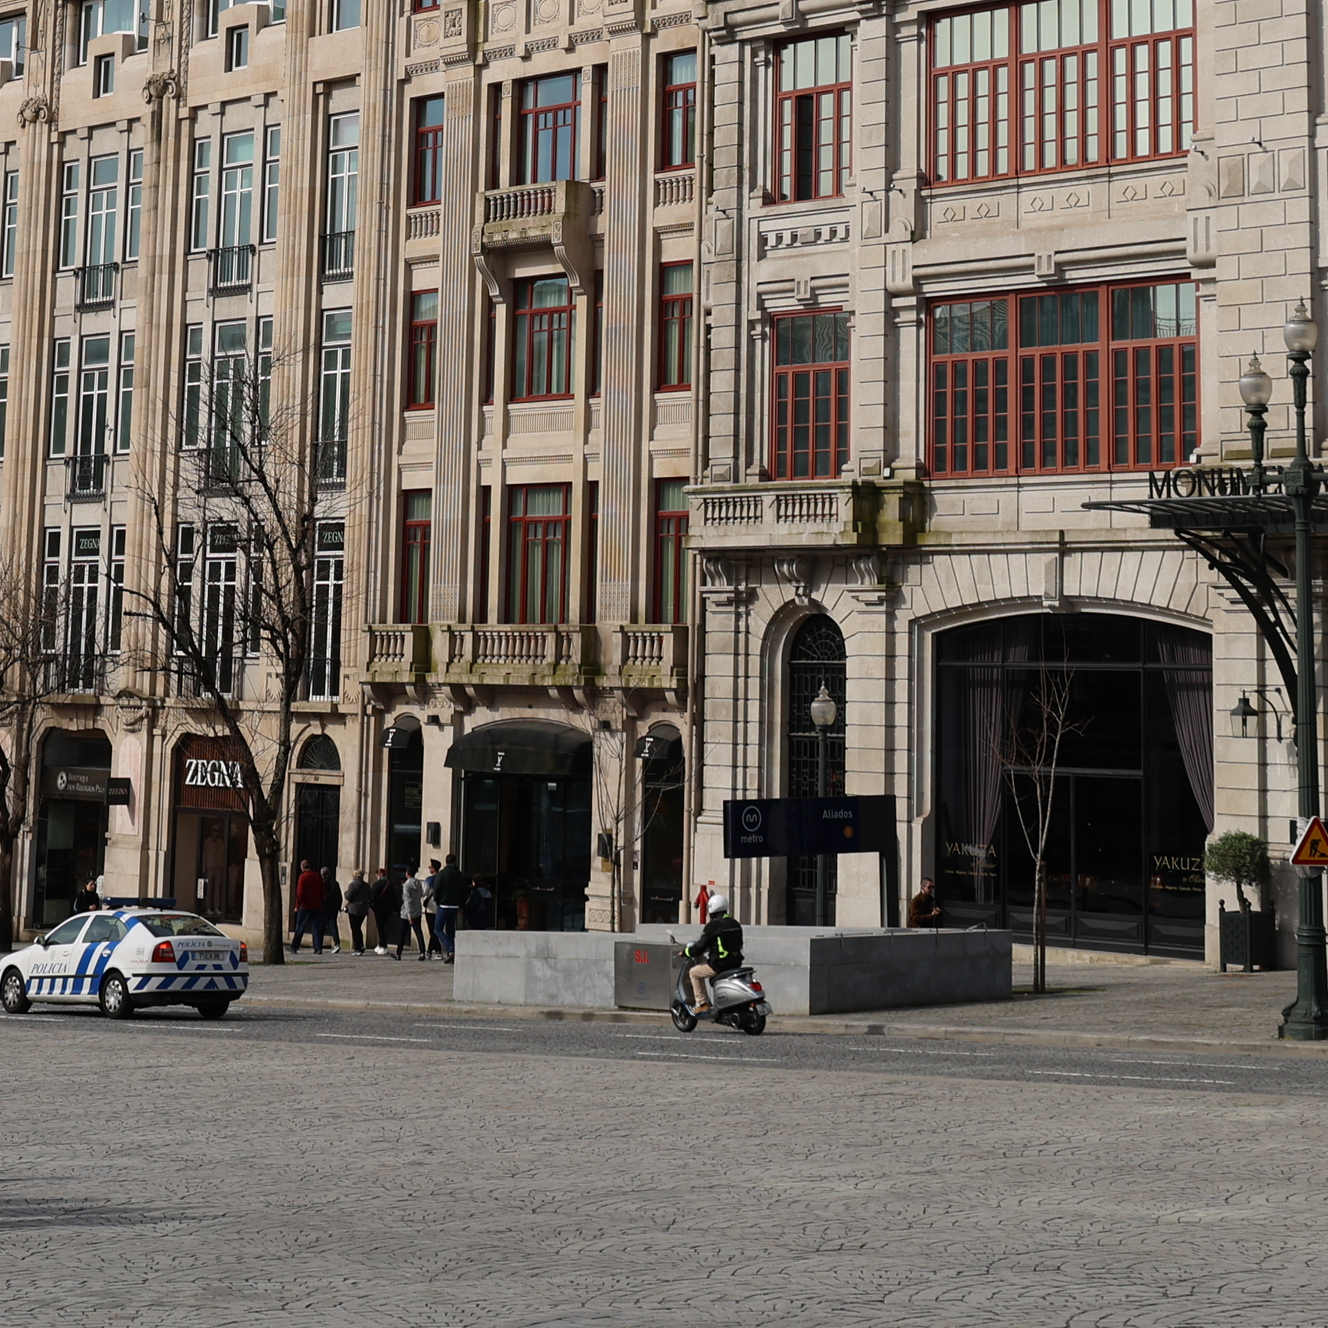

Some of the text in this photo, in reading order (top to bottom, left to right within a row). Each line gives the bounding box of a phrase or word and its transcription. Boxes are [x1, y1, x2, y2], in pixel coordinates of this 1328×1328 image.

[322, 530, 344, 544] ZEGN
[184, 758, 244, 789] ZEGNA
[822, 809, 853, 820] Aliados
[740, 833, 764, 845] metro
[1153, 856, 1202, 872] YAKUZ
